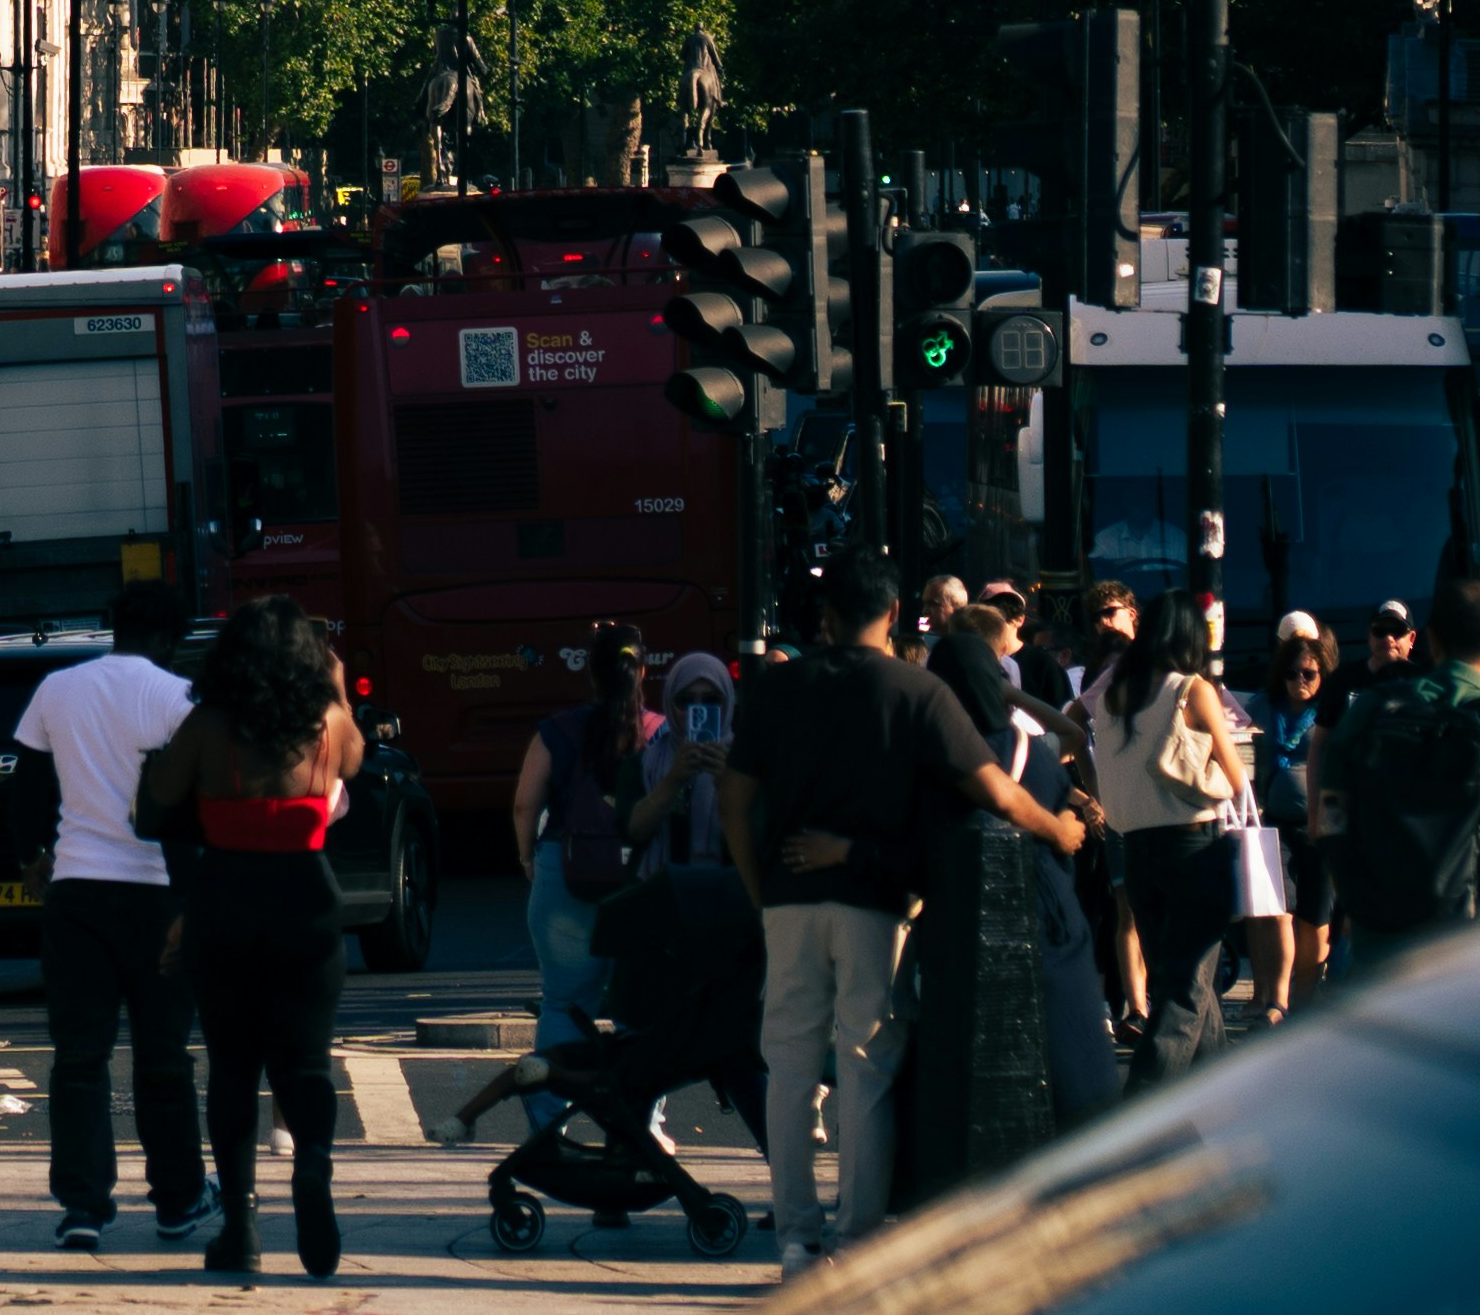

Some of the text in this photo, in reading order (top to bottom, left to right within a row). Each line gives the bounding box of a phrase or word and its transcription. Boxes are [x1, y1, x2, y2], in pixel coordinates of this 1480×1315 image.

[87, 317, 142, 332] 623630
[526, 330, 593, 349] Scan &
[527, 349, 606, 365] discover
[528, 365, 598, 383] the city
[634, 497, 686, 513] 15029
[450, 673, 501, 690] London
